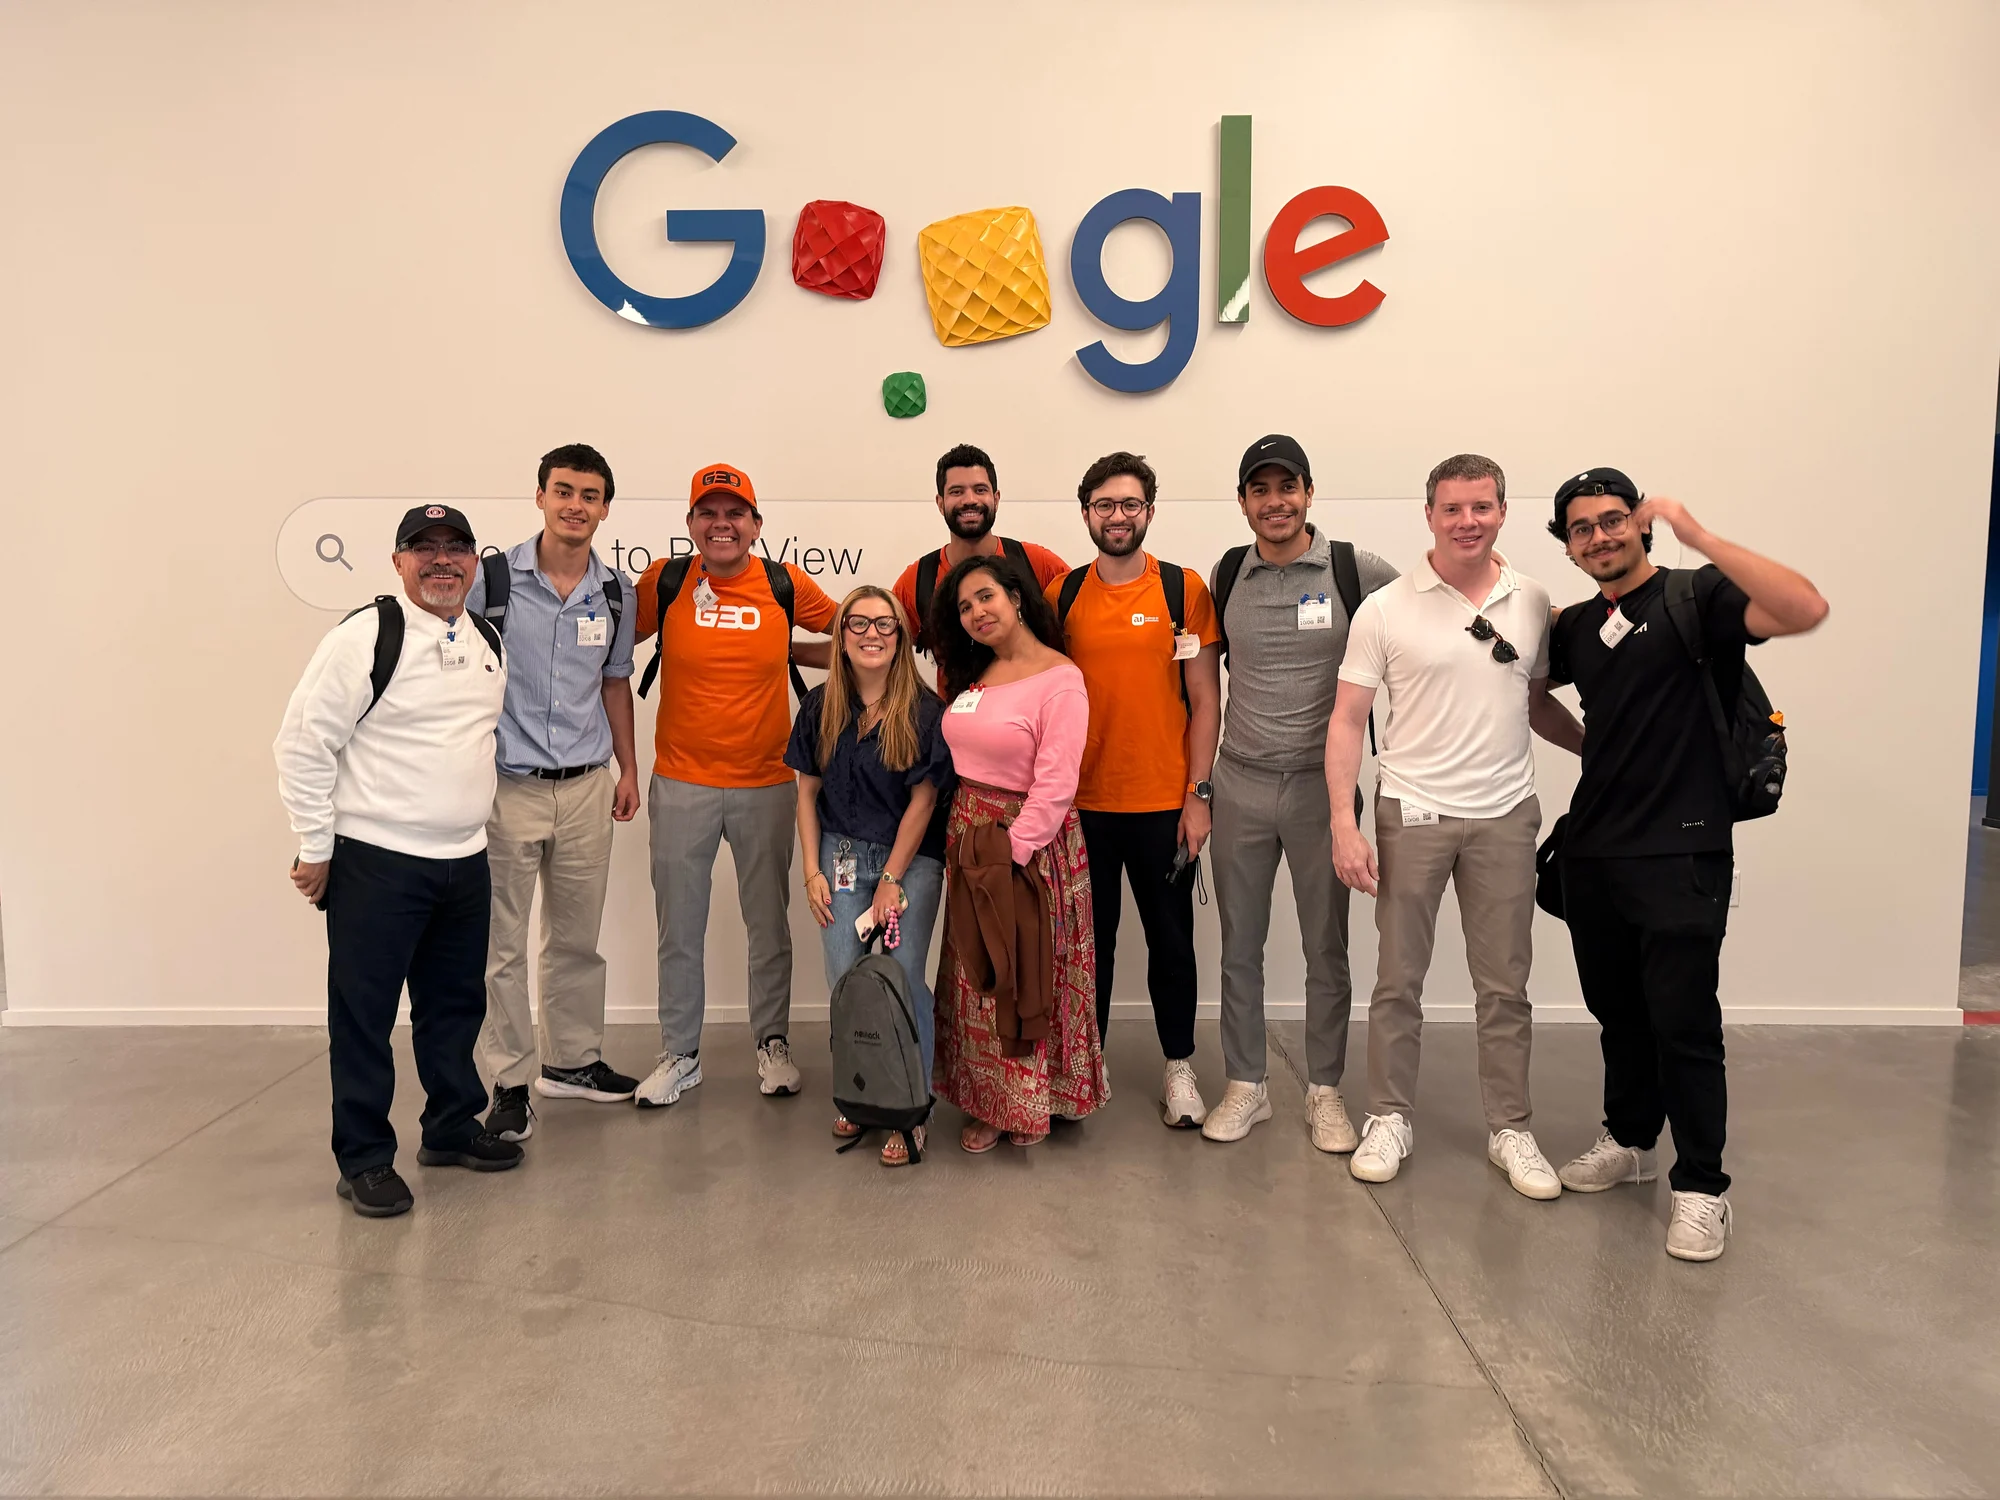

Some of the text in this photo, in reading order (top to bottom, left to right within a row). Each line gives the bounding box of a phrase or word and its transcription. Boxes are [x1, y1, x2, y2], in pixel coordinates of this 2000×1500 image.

[560, 109, 1390, 393] Ggle
[611, 538, 651, 575] to
[760, 536, 863, 575] View
